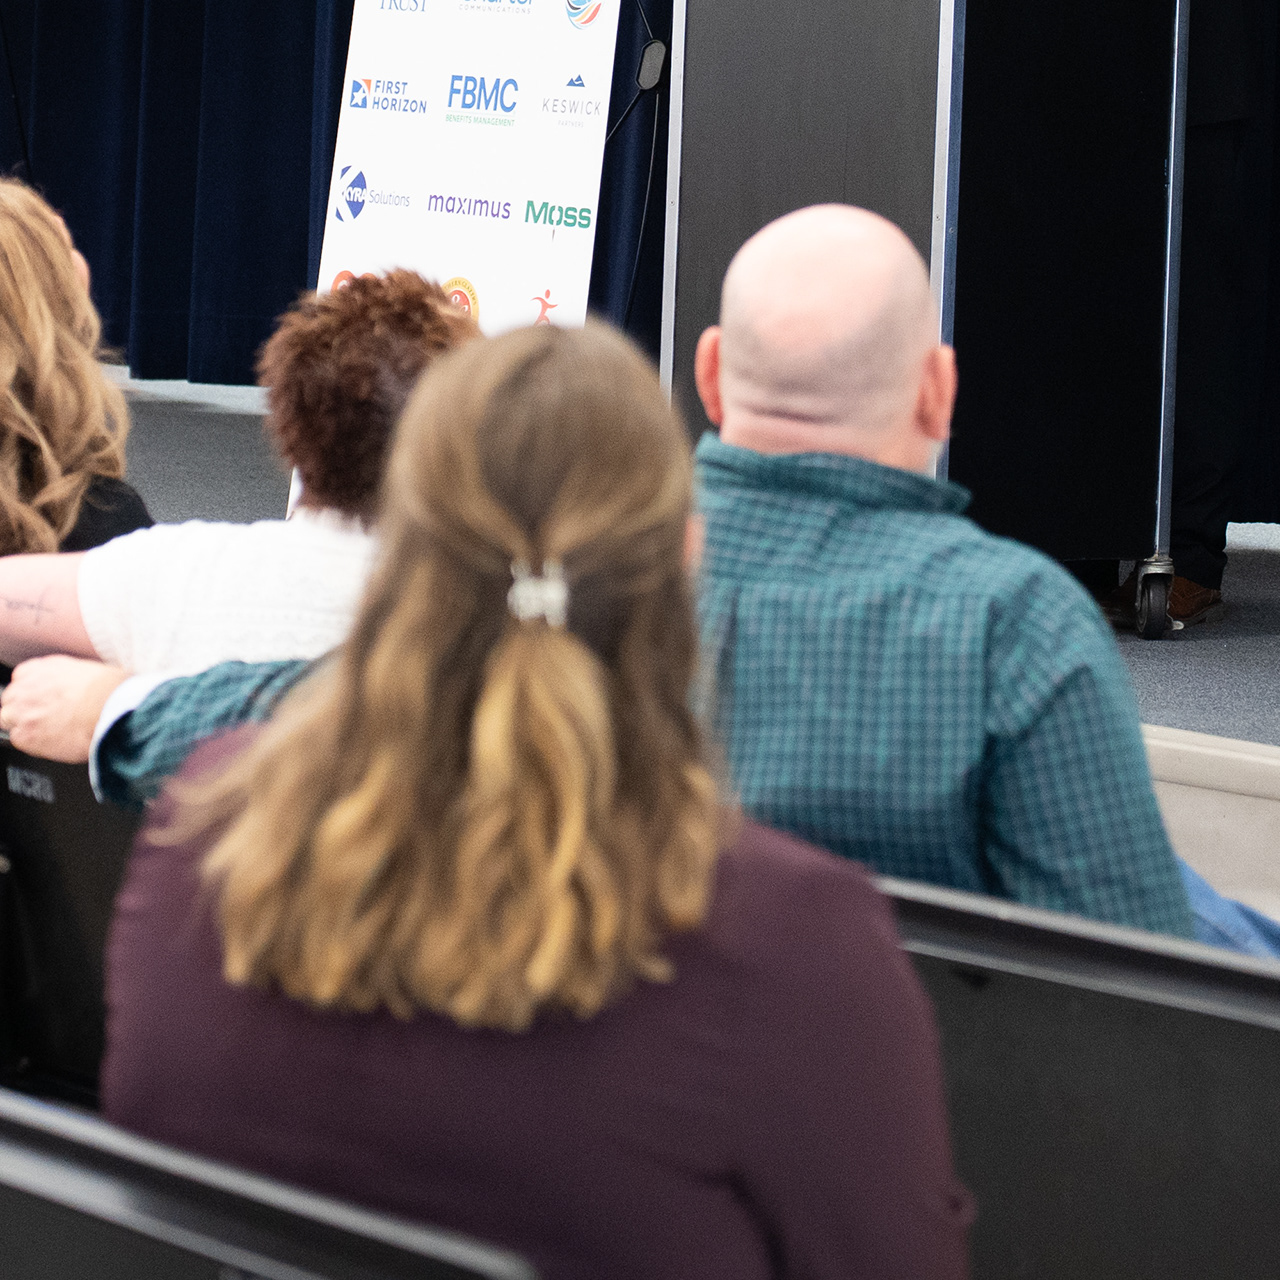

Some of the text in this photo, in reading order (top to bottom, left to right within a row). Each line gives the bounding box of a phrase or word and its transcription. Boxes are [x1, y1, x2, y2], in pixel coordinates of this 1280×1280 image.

[459, 3, 531, 14] COMMUNICATIONS
[374, 80, 408, 95] FIRST
[447, 75, 518, 113] FBMC
[372, 96, 427, 113] HORIZON
[542, 98, 601, 116] KESWICK
[445, 113, 515, 127] BENEFITS MANAGEMENT
[368, 189, 410, 207] Solutions
[428, 194, 511, 219] maximus
